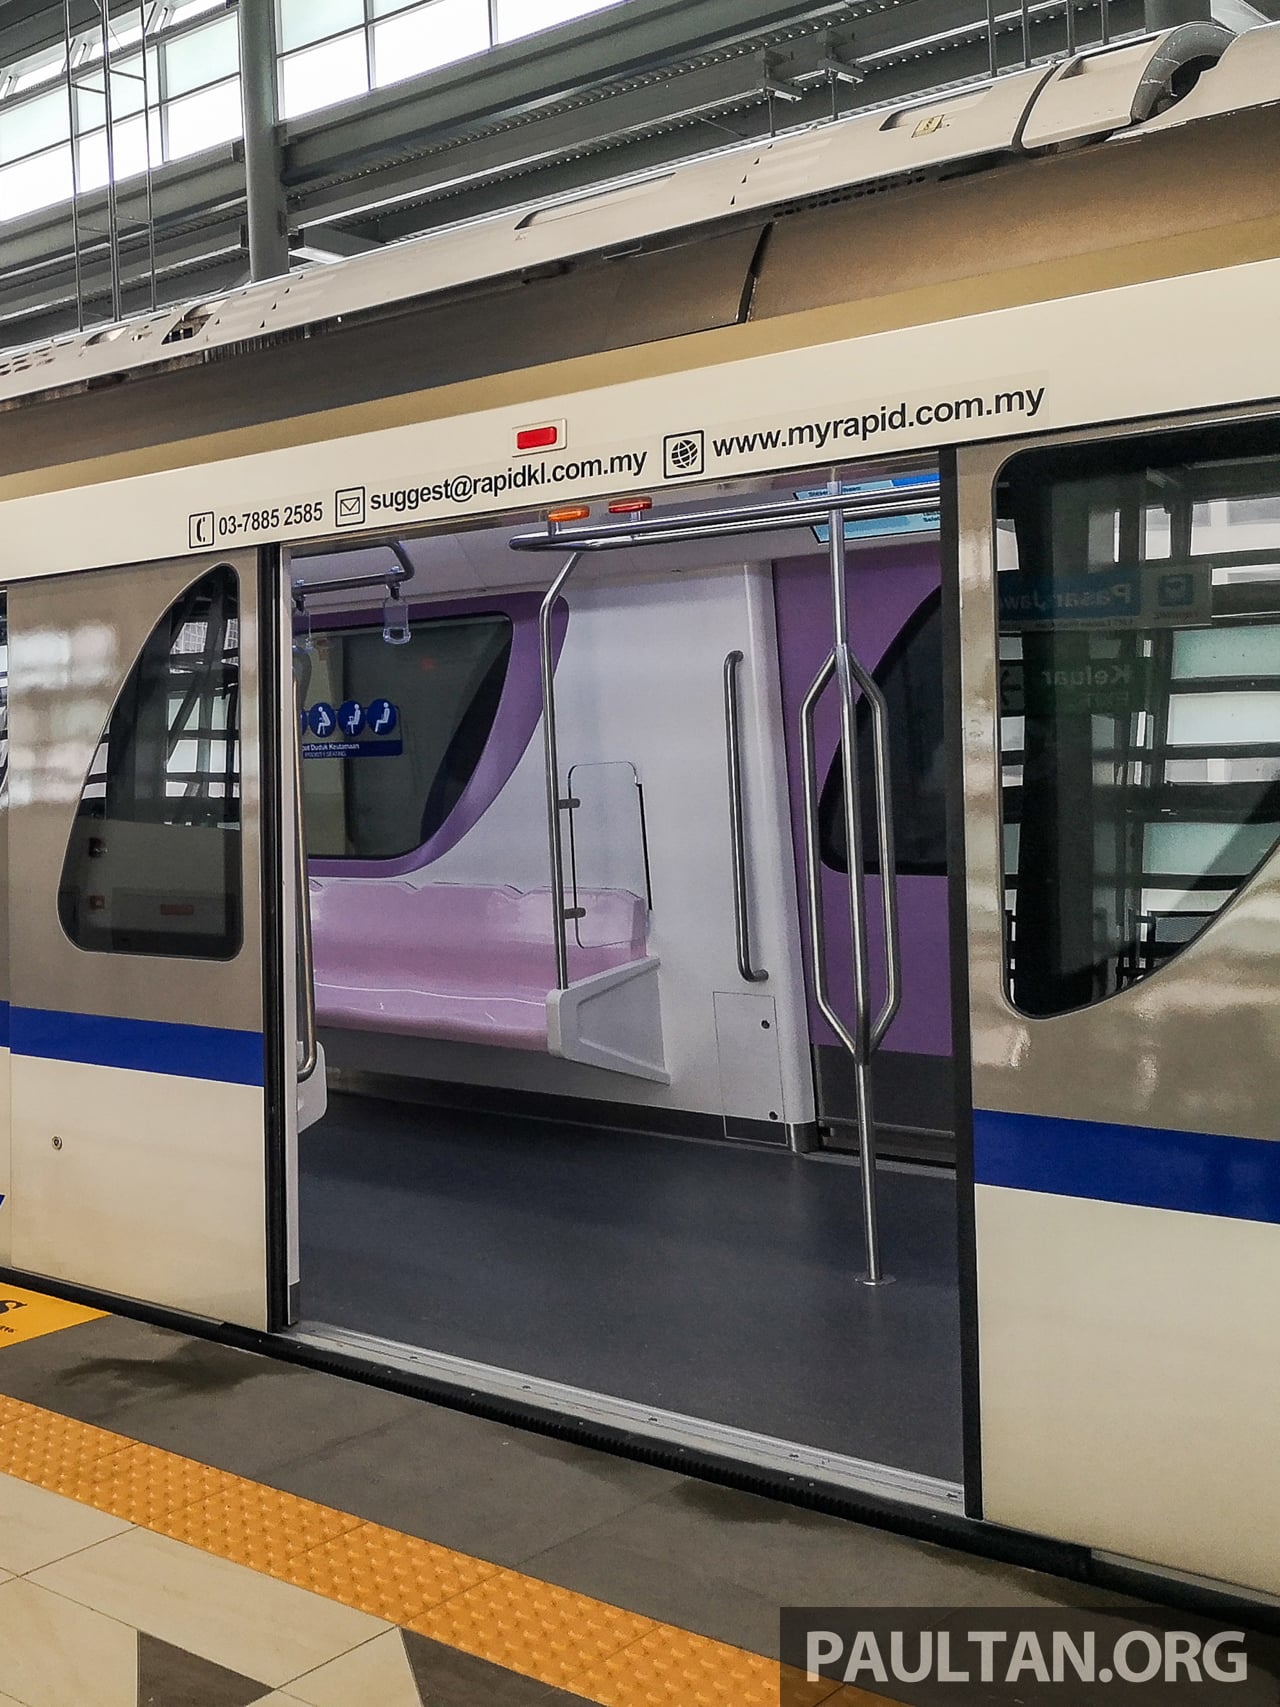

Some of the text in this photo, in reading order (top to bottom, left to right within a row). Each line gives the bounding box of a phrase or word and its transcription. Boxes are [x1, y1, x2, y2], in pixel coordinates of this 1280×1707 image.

[218, 387, 1045, 536] 03-7885 2585 suggest@rapidkl.com.my www.myrapid.com.my
